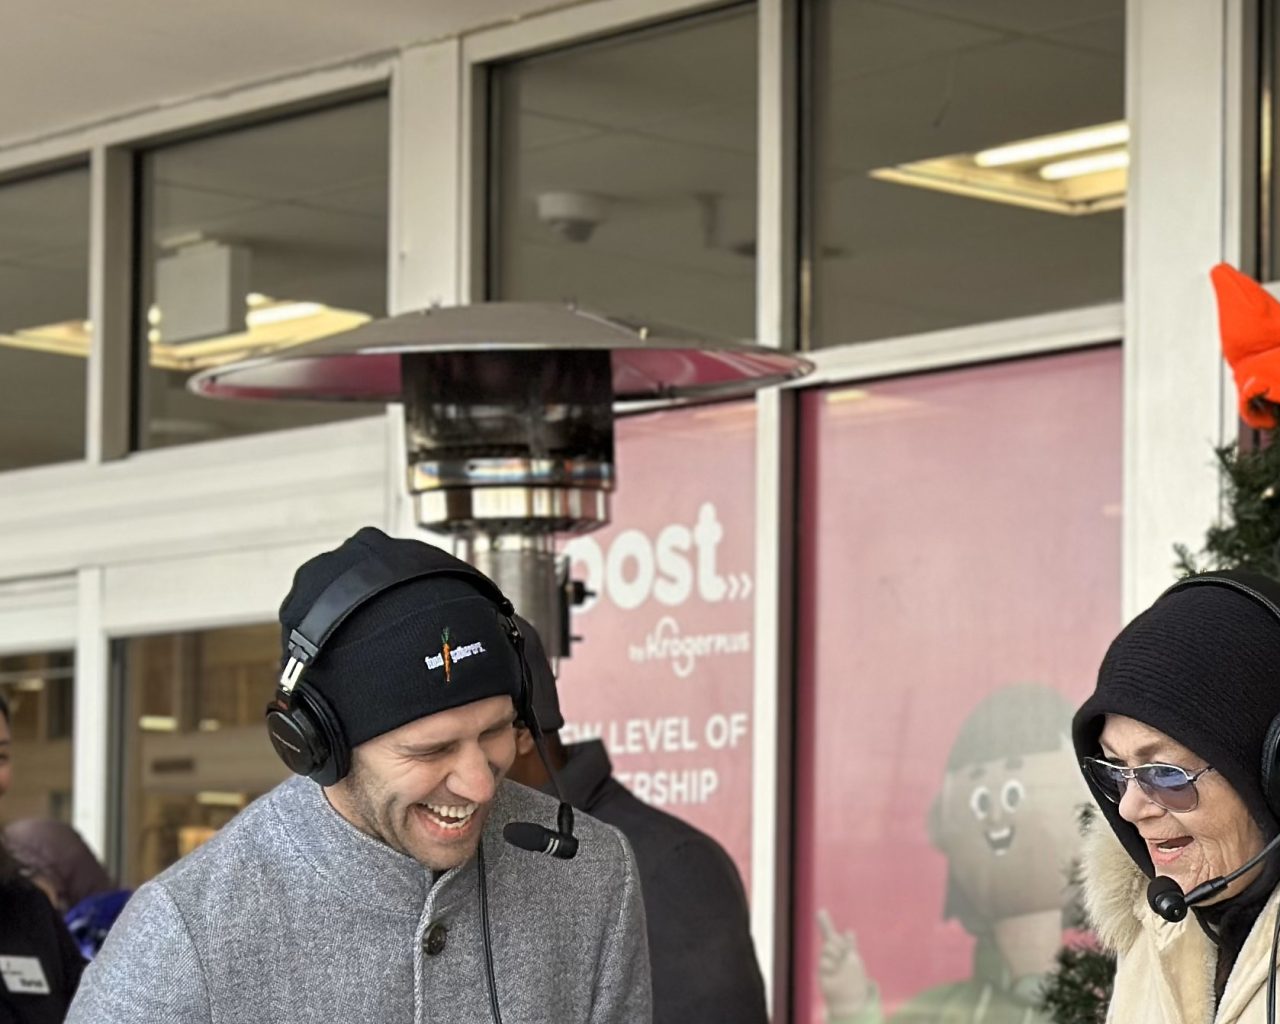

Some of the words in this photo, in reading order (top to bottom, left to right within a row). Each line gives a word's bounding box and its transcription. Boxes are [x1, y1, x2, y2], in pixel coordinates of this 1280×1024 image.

[558, 501, 727, 614] oost
[609, 716, 698, 755] LEVEL
[705, 713, 748, 749] OF
[612, 769, 718, 804] RSHIP
